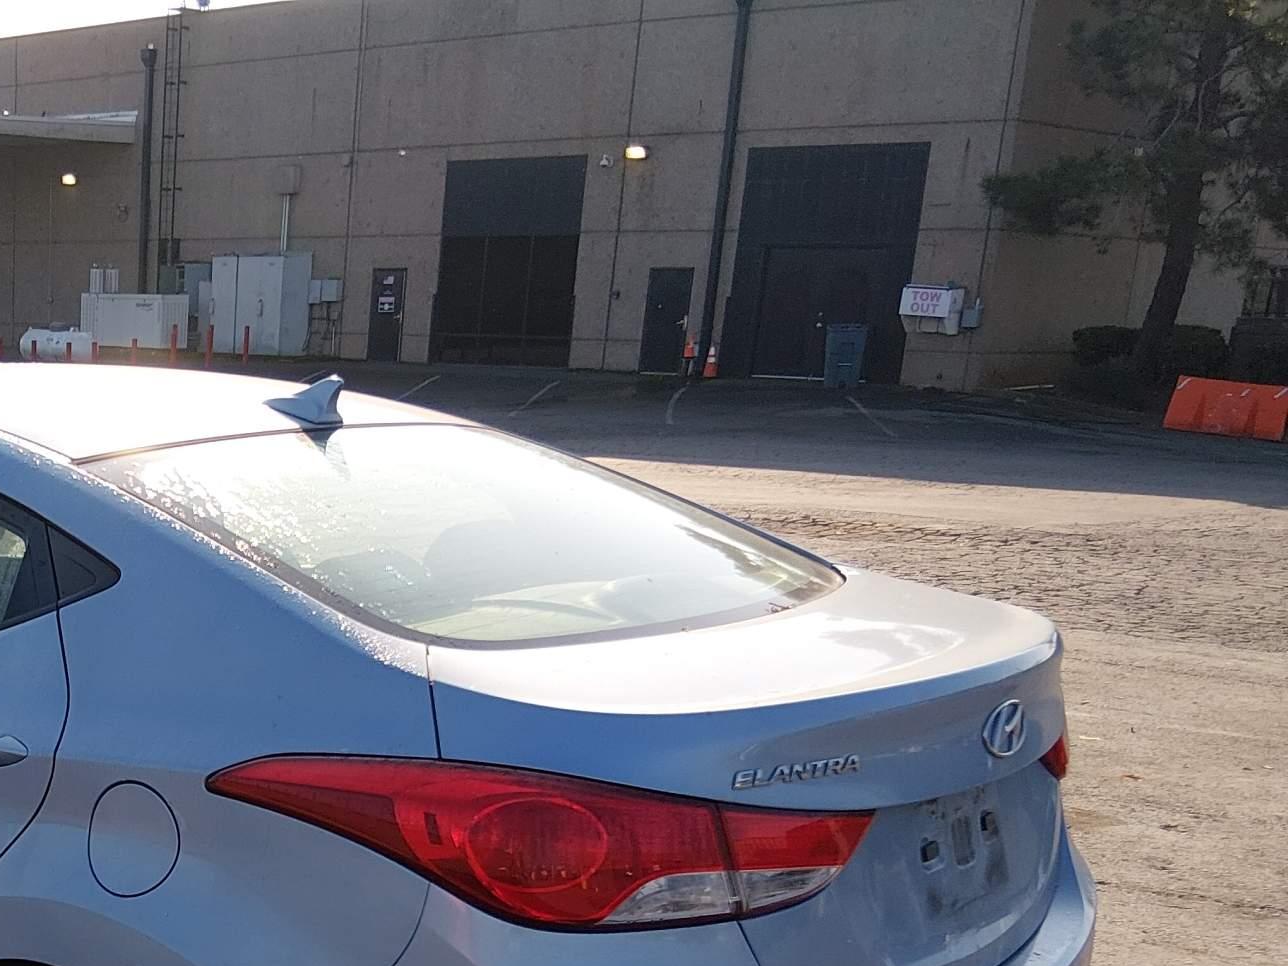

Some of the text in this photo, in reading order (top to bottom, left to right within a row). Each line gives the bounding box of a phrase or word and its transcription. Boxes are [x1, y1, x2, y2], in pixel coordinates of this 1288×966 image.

[911, 290, 943, 303] TOW
[910, 302, 939, 314] OUT
[731, 753, 860, 791] ELANTRA
